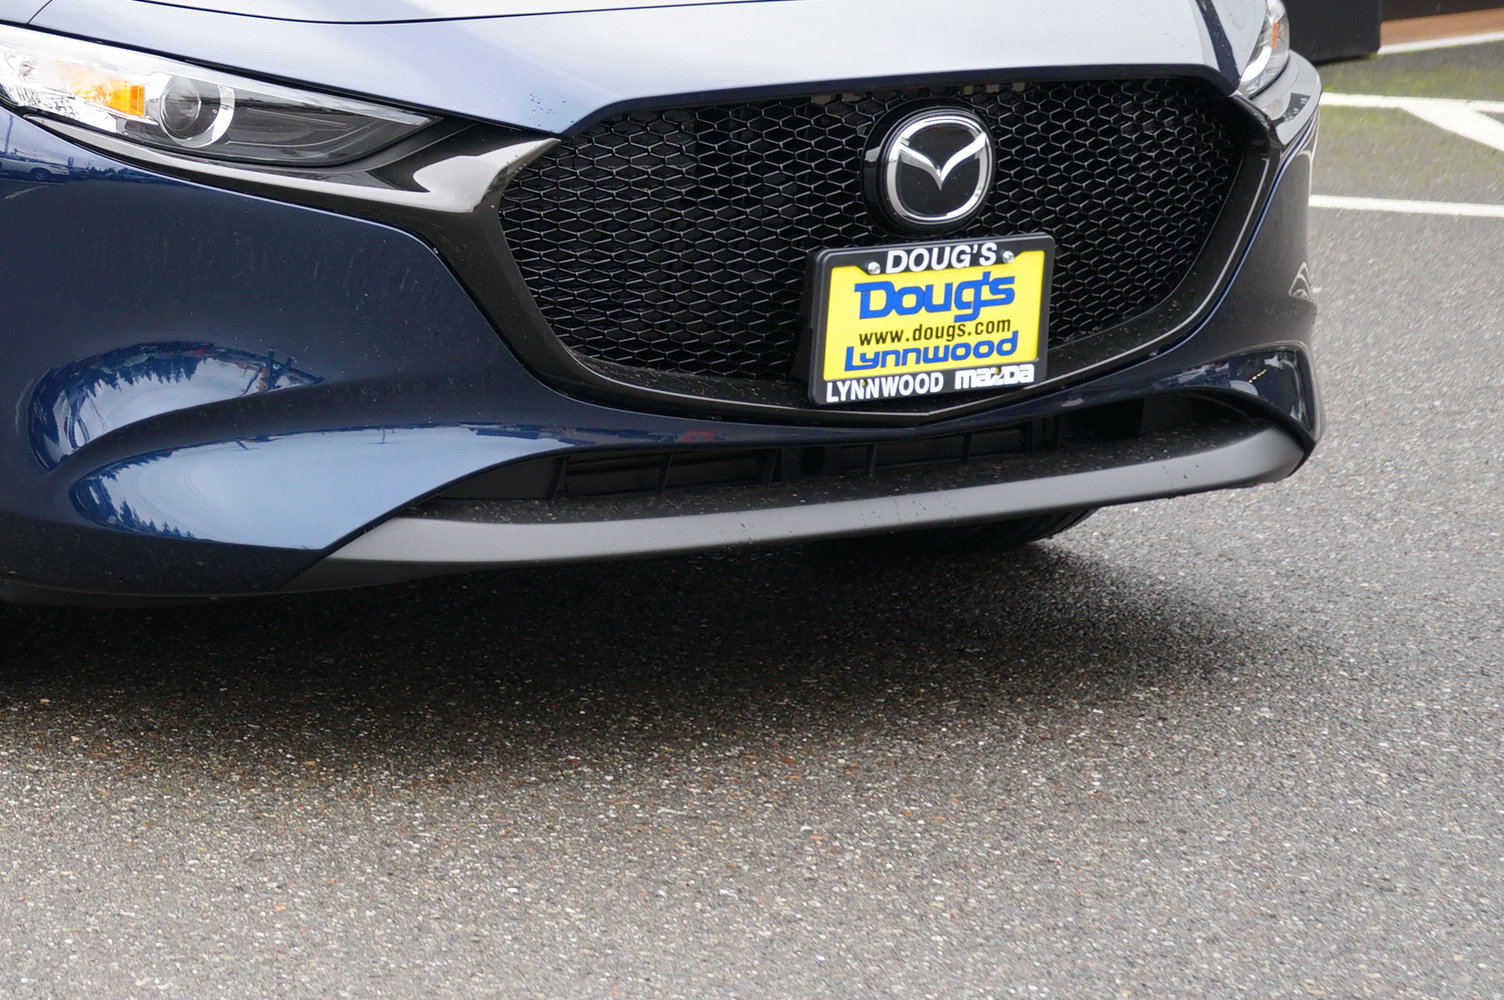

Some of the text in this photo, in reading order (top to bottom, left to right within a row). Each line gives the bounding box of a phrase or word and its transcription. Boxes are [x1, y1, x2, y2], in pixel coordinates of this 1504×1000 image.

[885, 242, 998, 275] DOUG'S
[854, 271, 1016, 323] Doug's
[858, 319, 1012, 347] www.dougs.com
[843, 330, 1019, 372] Lynnwood
[826, 372, 944, 404] LYNNWOOD
